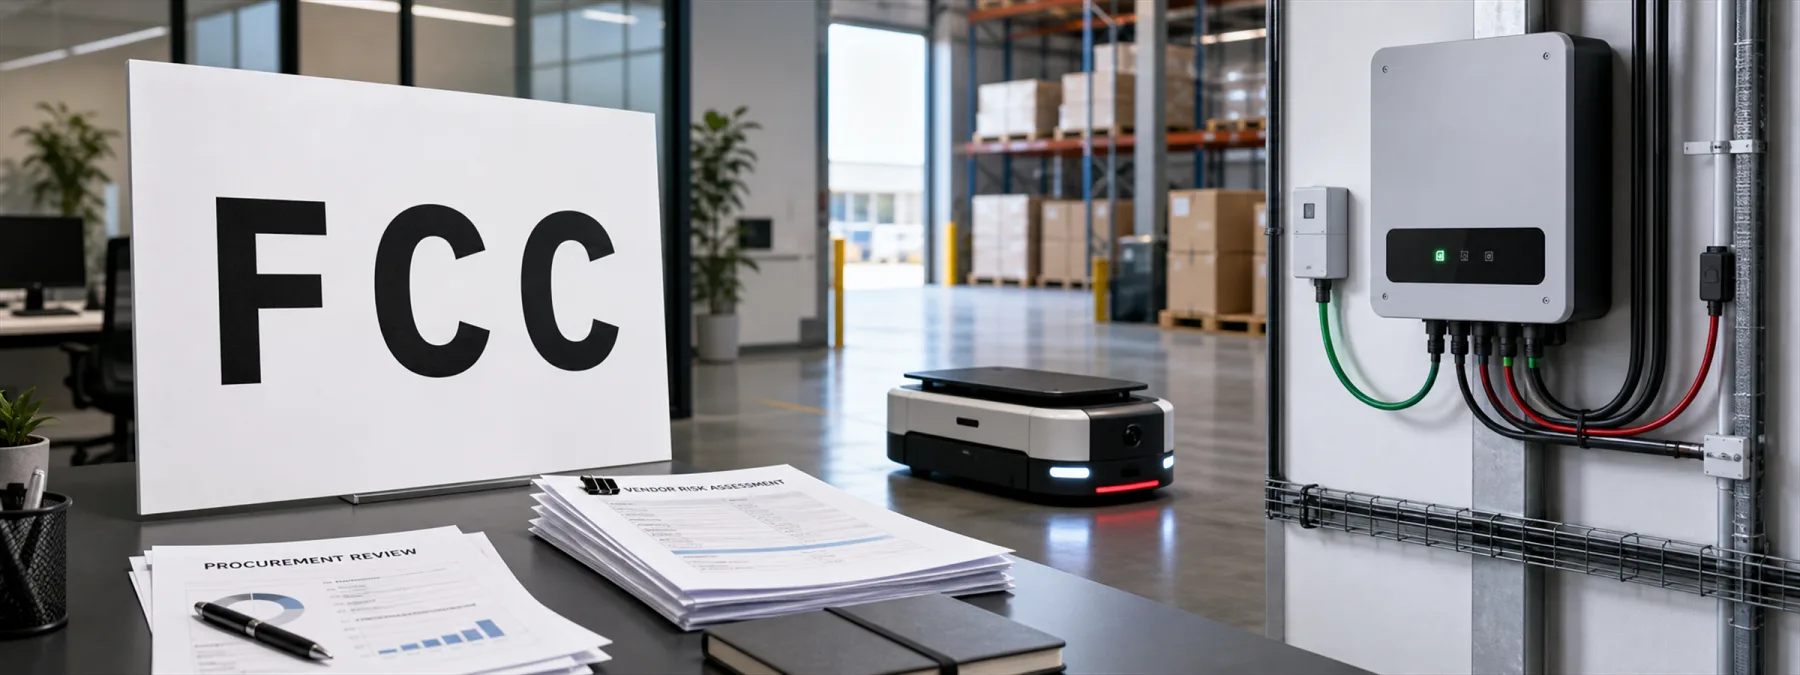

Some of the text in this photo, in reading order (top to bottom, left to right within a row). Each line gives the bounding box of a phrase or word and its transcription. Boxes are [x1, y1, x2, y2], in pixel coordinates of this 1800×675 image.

[216, 197, 620, 386] FCC
[710, 479, 785, 491] ASSESSMENT
[204, 548, 417, 570] PROCUREMENT REVIEW
